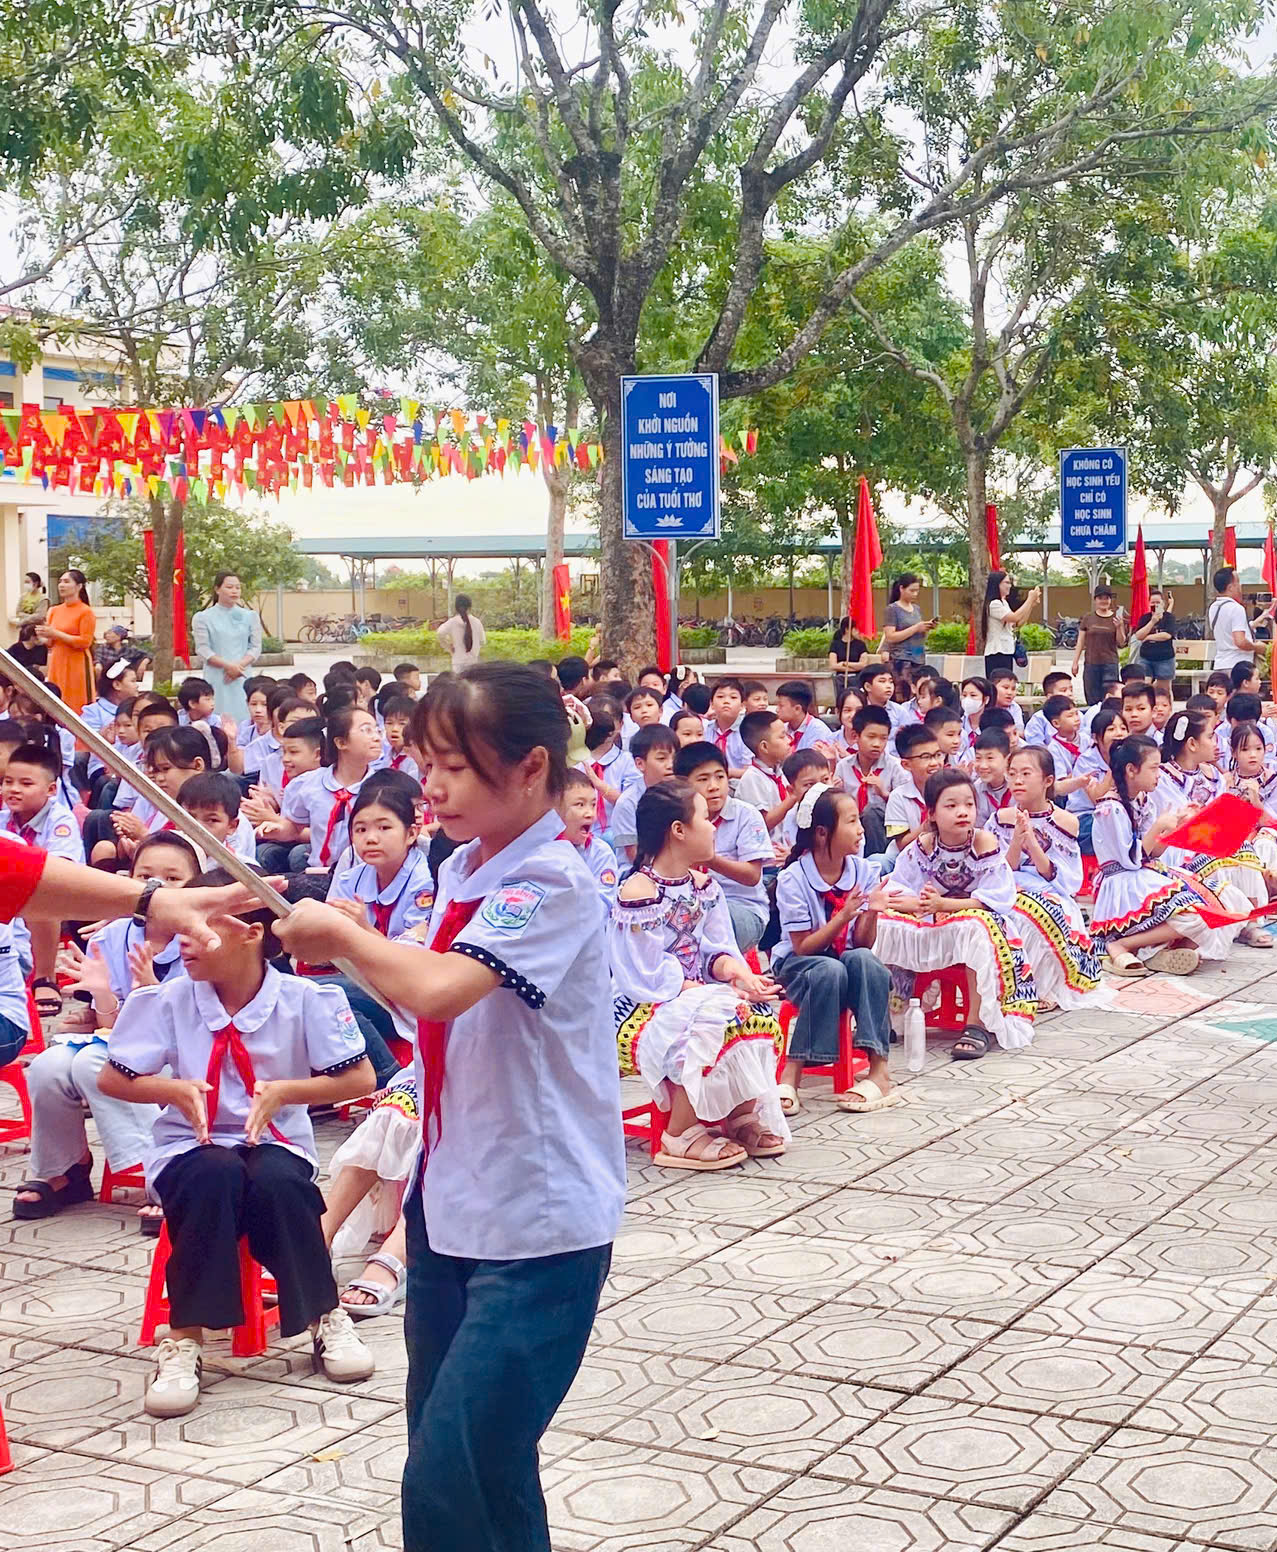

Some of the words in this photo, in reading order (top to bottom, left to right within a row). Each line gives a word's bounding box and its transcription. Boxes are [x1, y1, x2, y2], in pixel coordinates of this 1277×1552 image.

[659, 392, 676, 408] NƠI
[638, 413, 661, 434] KHỞI
[630, 441, 663, 459] NHỮNG
[666, 440, 672, 458] Ý
[675, 438, 708, 458] TƯỞNG
[1073, 458, 1100, 470] KHÔNG
[1102, 457, 1113, 469] CÓ
[645, 466, 672, 484] SÁNG
[674, 468, 693, 486] TẠO
[1066, 477, 1082, 489] HỌC
[1084, 476, 1103, 486] SINH
[1105, 473, 1120, 486] YẾU
[637, 489, 656, 508] CỦA
[659, 487, 680, 508] TUỔI
[683, 491, 702, 508] THƠ
[1080, 489, 1093, 503] CHỈ
[1096, 491, 1106, 502] CÓ
[1075, 510, 1090, 521] HỌC
[1092, 509, 1112, 519] SINH
[1070, 525, 1091, 536] CHƯA
[1093, 523, 1116, 536] CHĂM
